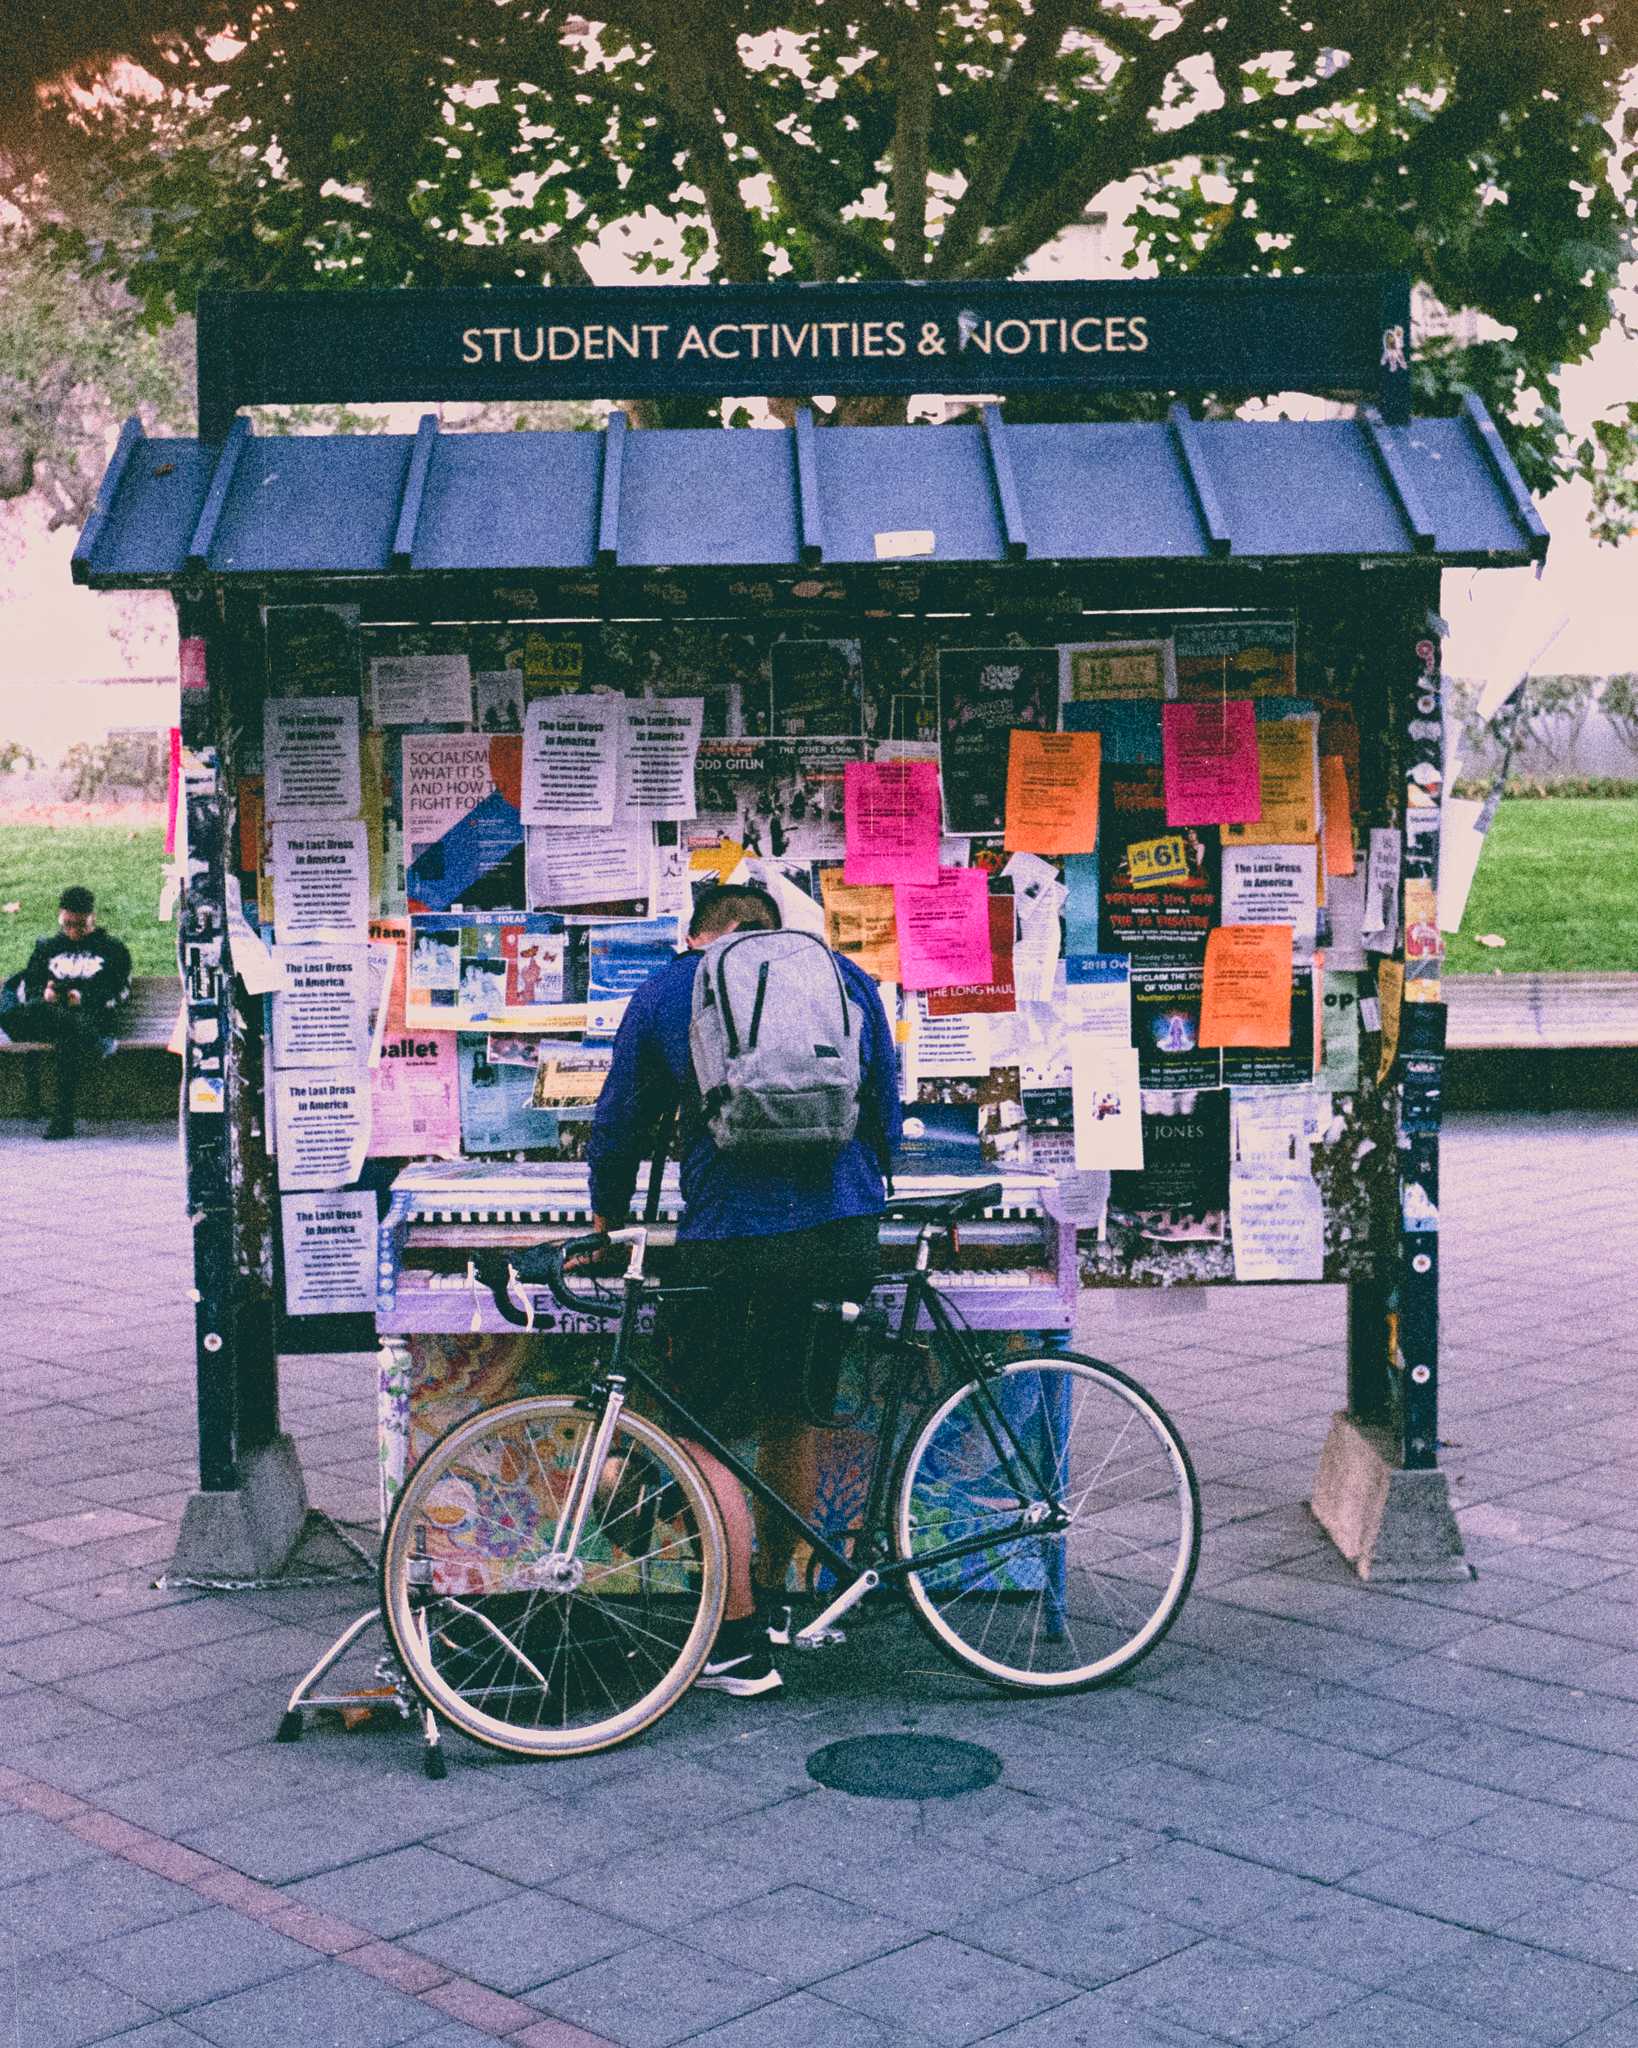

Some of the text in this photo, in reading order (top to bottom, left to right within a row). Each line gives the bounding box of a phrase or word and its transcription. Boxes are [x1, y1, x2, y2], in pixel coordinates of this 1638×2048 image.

[463, 316, 1148, 363] STUDENT ACTIVITIES & NOTICES
[695, 759, 721, 769] ODD
[410, 765, 485, 780] WHAT IT IS
[410, 782, 443, 796] AND
[446, 781, 484, 795] HOW
[410, 798, 451, 811] FIGHT
[288, 840, 305, 850] The
[1235, 863, 1252, 873] The
[286, 963, 353, 973] The Last Dress
[305, 977, 345, 987] America
[1131, 974, 1169, 982] RECLAIM
[950, 985, 984, 997] LONG
[986, 984, 1016, 995] HAUL
[1158, 983, 1183, 992] YOUR
[290, 1085, 356, 1097] The Last Dress
[309, 1100, 349, 1111] America
[1155, 1125, 1205, 1139] JONES
[296, 1212, 314, 1222] The
[315, 1211, 335, 1221] Last
[316, 1225, 356, 1235] America
